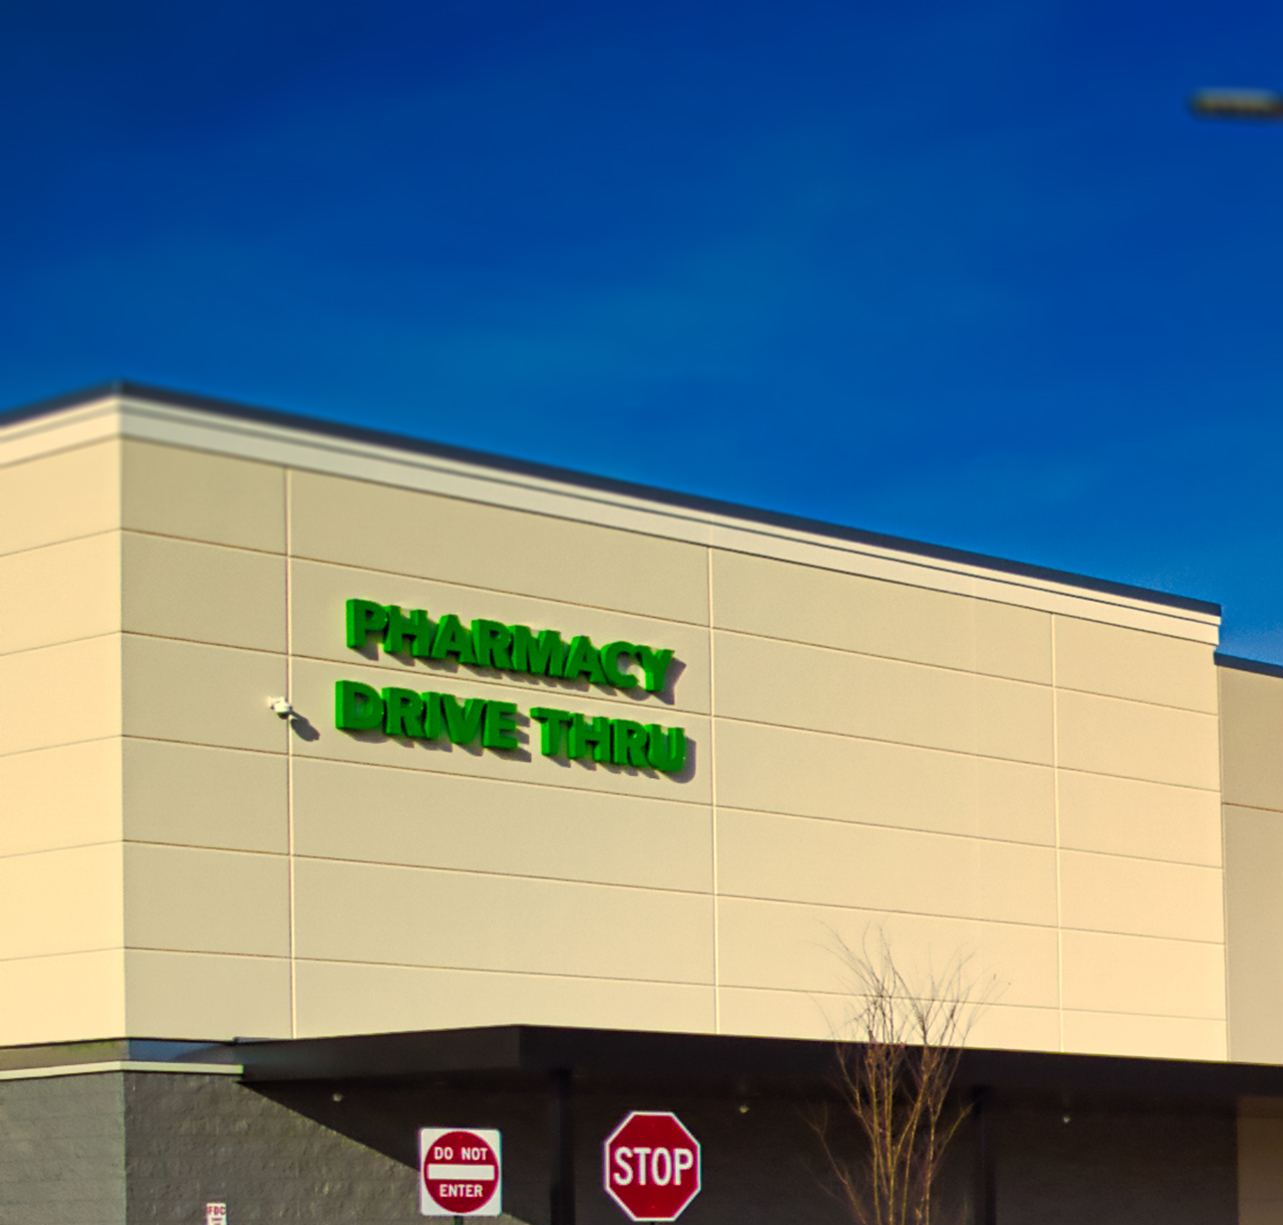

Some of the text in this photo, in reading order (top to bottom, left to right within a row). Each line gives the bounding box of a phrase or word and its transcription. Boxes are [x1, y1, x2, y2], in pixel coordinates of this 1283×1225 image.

[346, 599, 675, 692] PHARMACY
[335, 680, 686, 772] DRIVE THRU
[434, 1147, 489, 1162] DO NOT
[614, 1147, 694, 1186] STOP
[439, 1184, 484, 1198] ENTER
